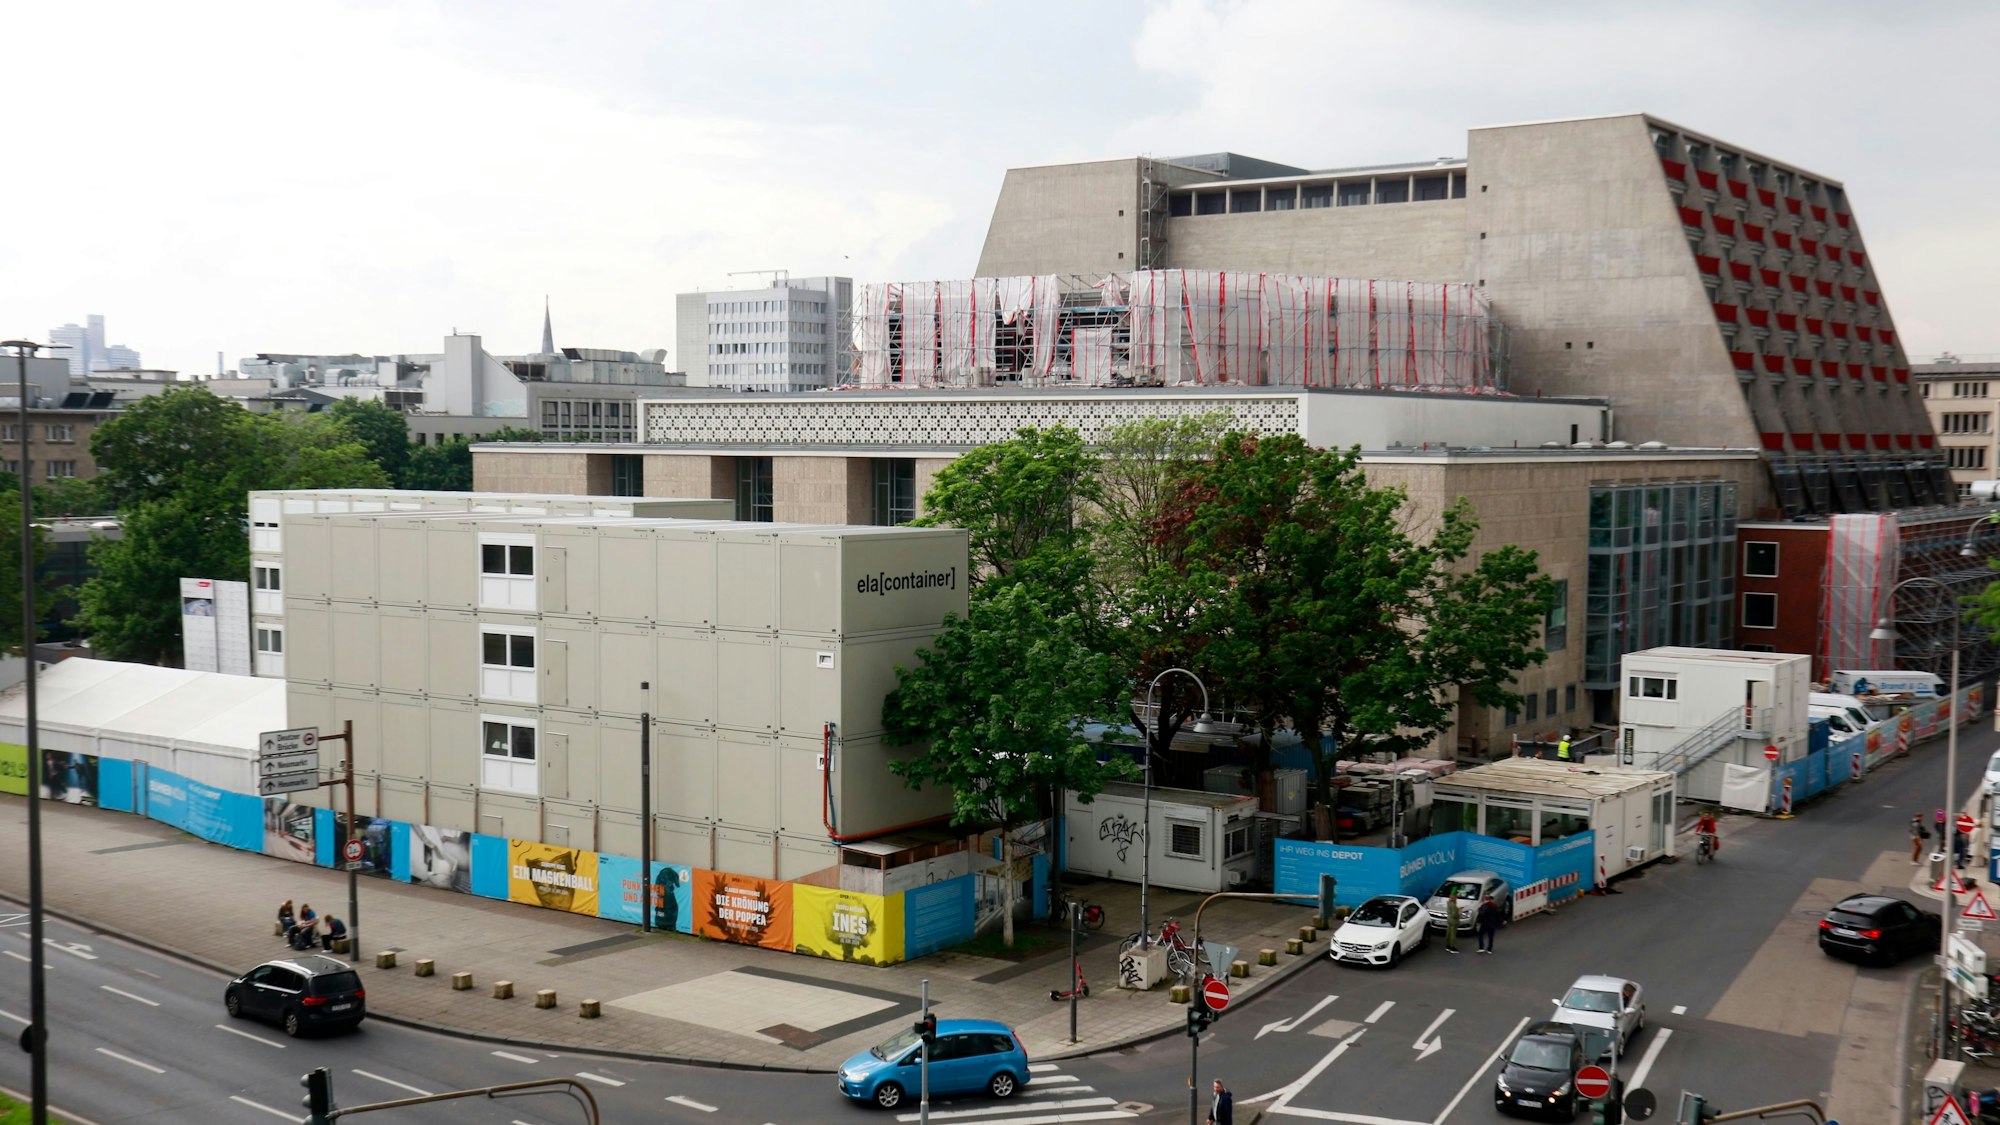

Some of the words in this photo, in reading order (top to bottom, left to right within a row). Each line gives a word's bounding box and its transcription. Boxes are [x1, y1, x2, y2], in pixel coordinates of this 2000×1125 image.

[857, 567, 955, 596] ela[container]
[277, 734, 300, 742] Deutzer
[278, 760, 308, 769] Neumarkt
[278, 779, 308, 788] Heumarkt
[1280, 845, 1294, 853] IHR
[1295, 847, 1315, 857] WEG
[1316, 849, 1330, 858] INS
[1331, 850, 1364, 861] DEPOT
[1400, 856, 1426, 879] BÜHNEN
[1427, 849, 1455, 866] KÖLN
[513, 864, 531, 881] EIN
[531, 868, 594, 893] MASKENBALL
[623, 891, 638, 903] UND
[715, 893, 730, 907] DIE
[731, 896, 769, 914] KRÖNUNG
[719, 907, 734, 920] DER
[735, 910, 767, 926] POPPEA
[832, 911, 868, 936] INES
